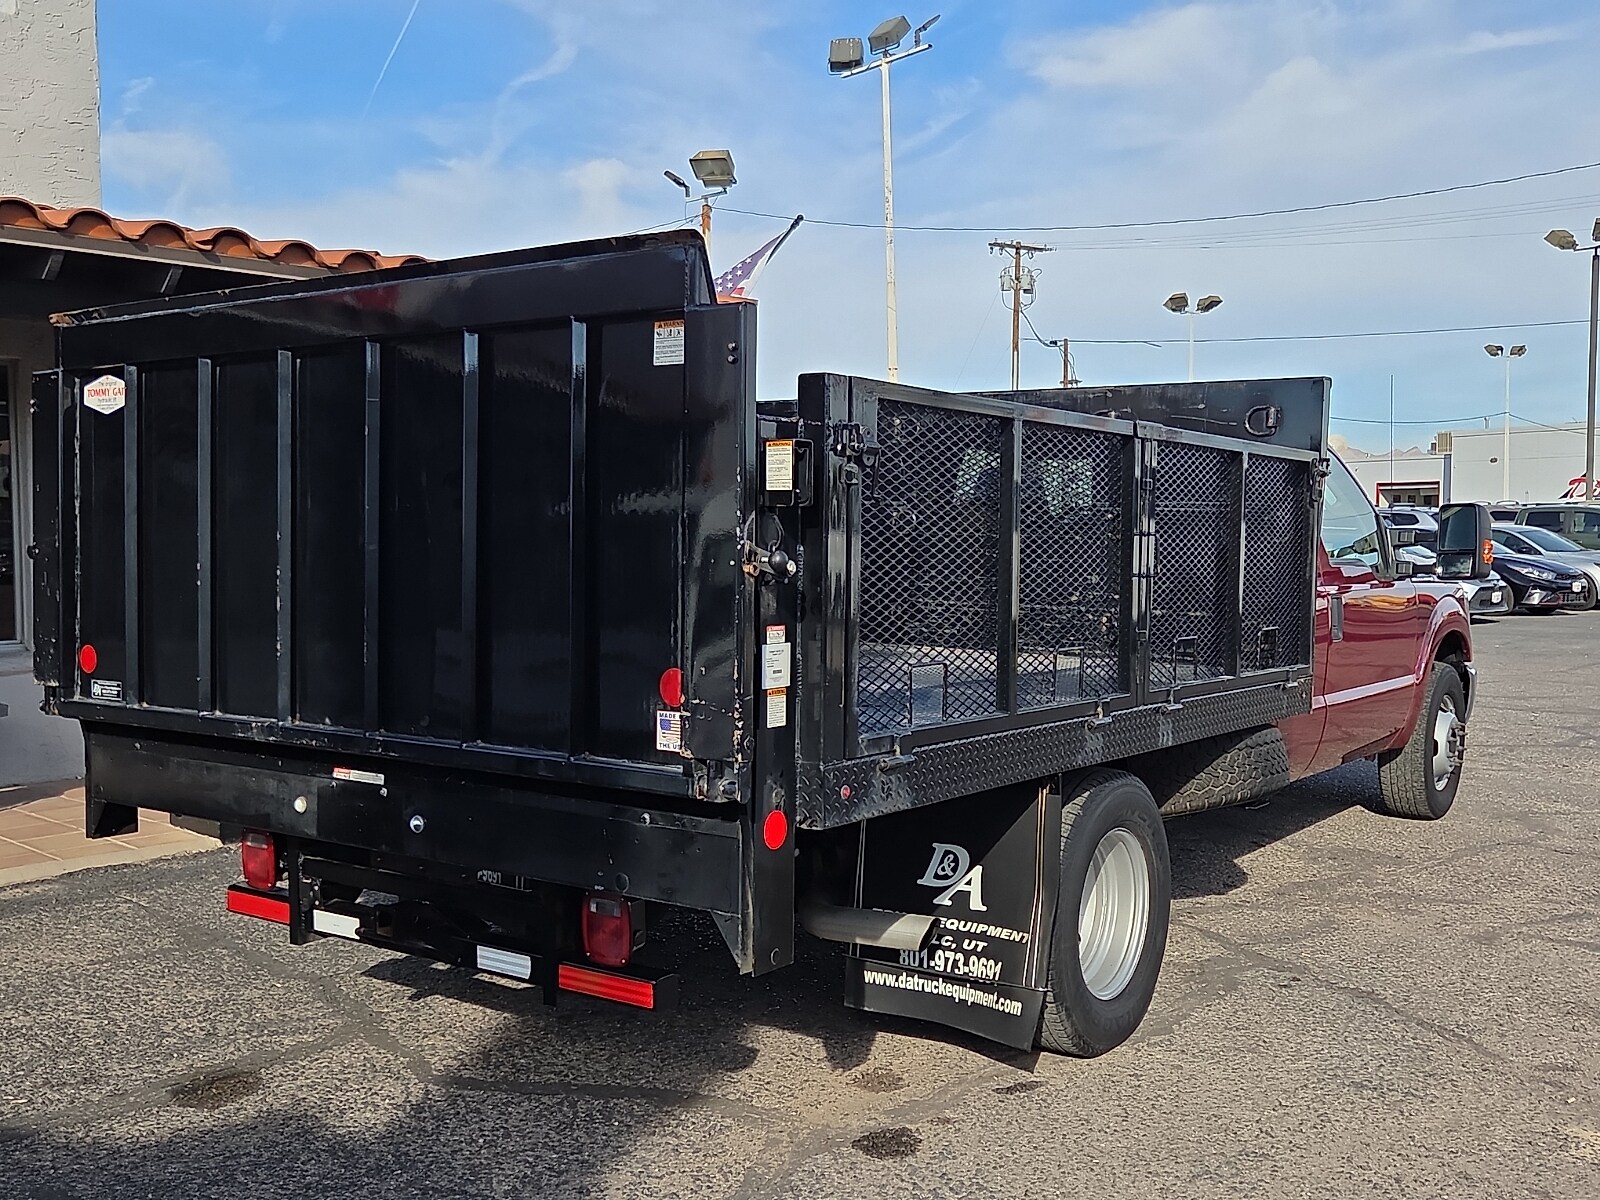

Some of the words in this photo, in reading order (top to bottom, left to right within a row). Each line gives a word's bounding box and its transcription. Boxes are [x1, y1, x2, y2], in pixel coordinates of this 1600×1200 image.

[87, 387, 110, 398] TOMMY
[930, 934, 958, 950] LC,
[962, 938, 989, 953] UT
[939, 916, 1031, 945] EQUIPMENT
[899, 947, 1003, 987] 801-973-9691
[863, 968, 1023, 1017] www.datruckequipment.com
